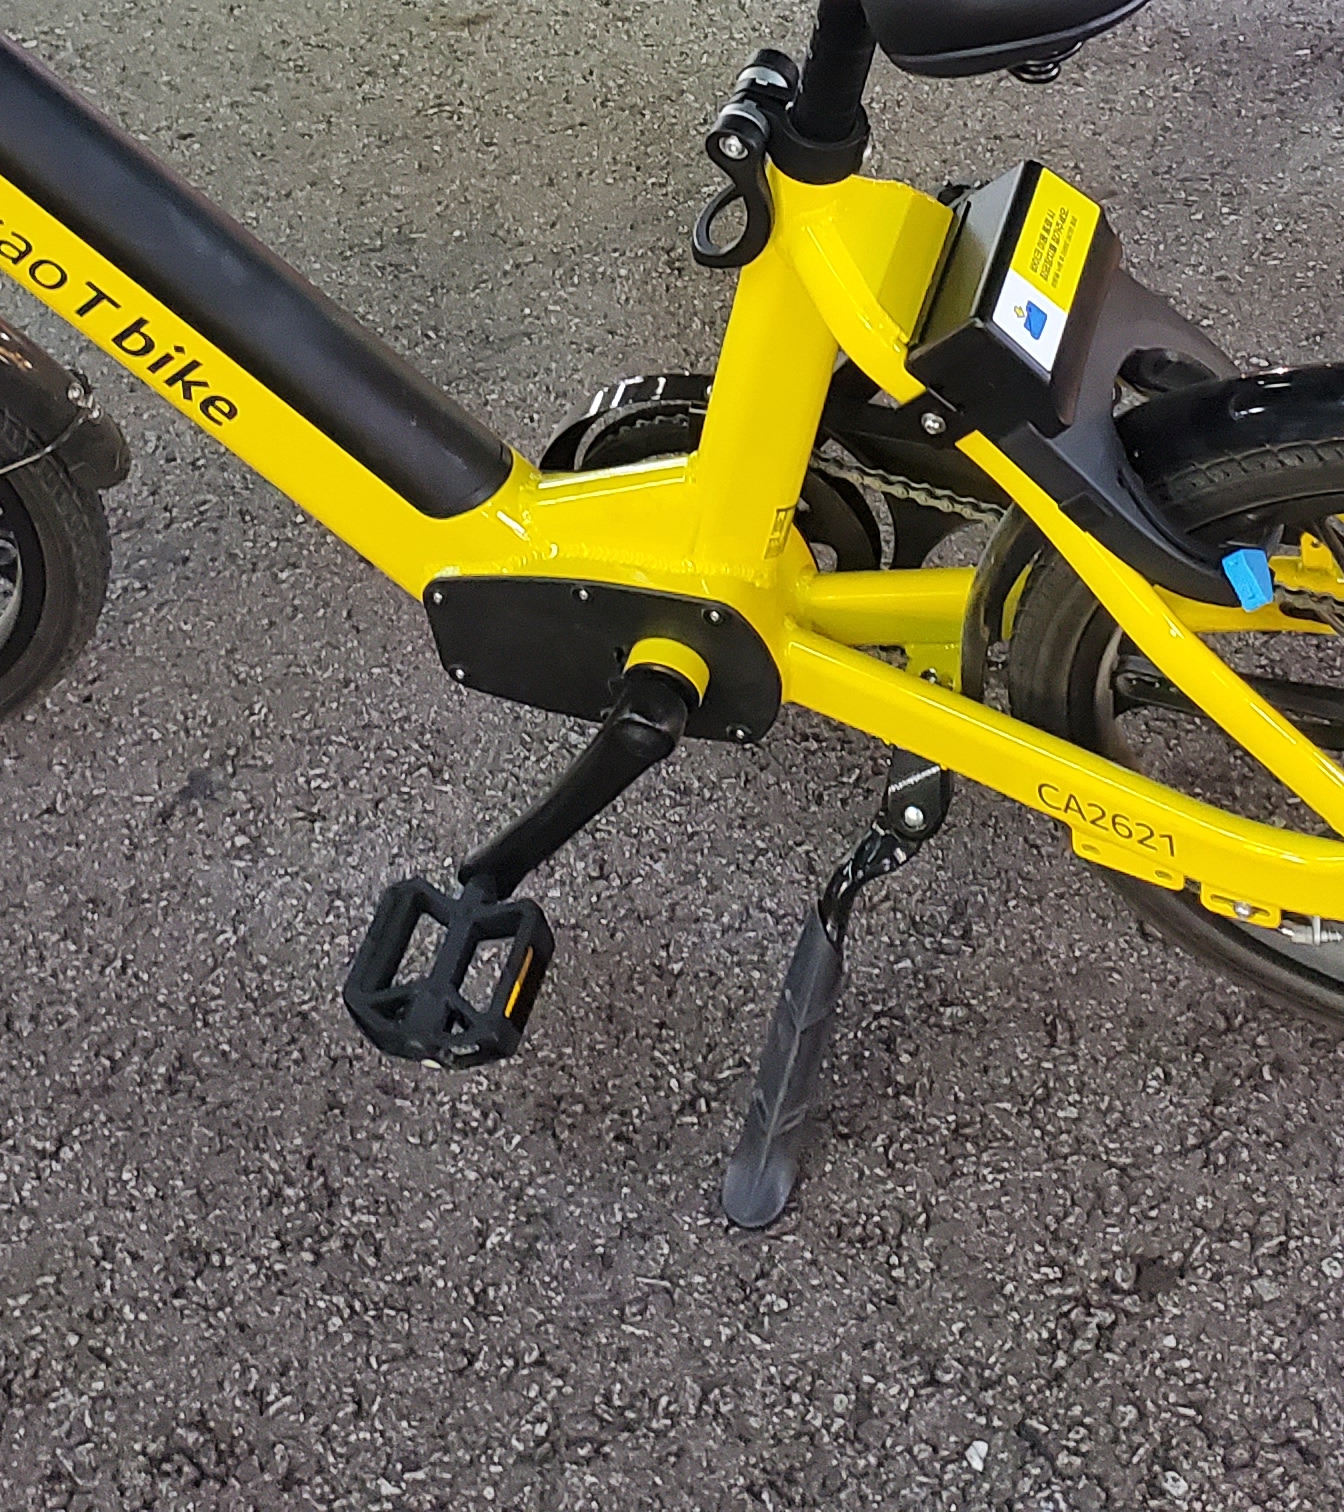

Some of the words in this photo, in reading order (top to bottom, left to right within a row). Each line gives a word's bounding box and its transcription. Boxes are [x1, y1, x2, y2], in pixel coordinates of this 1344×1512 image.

[73, 281, 122, 318] T
[111, 319, 238, 427] bike
[1037, 783, 1176, 857] CA2621
